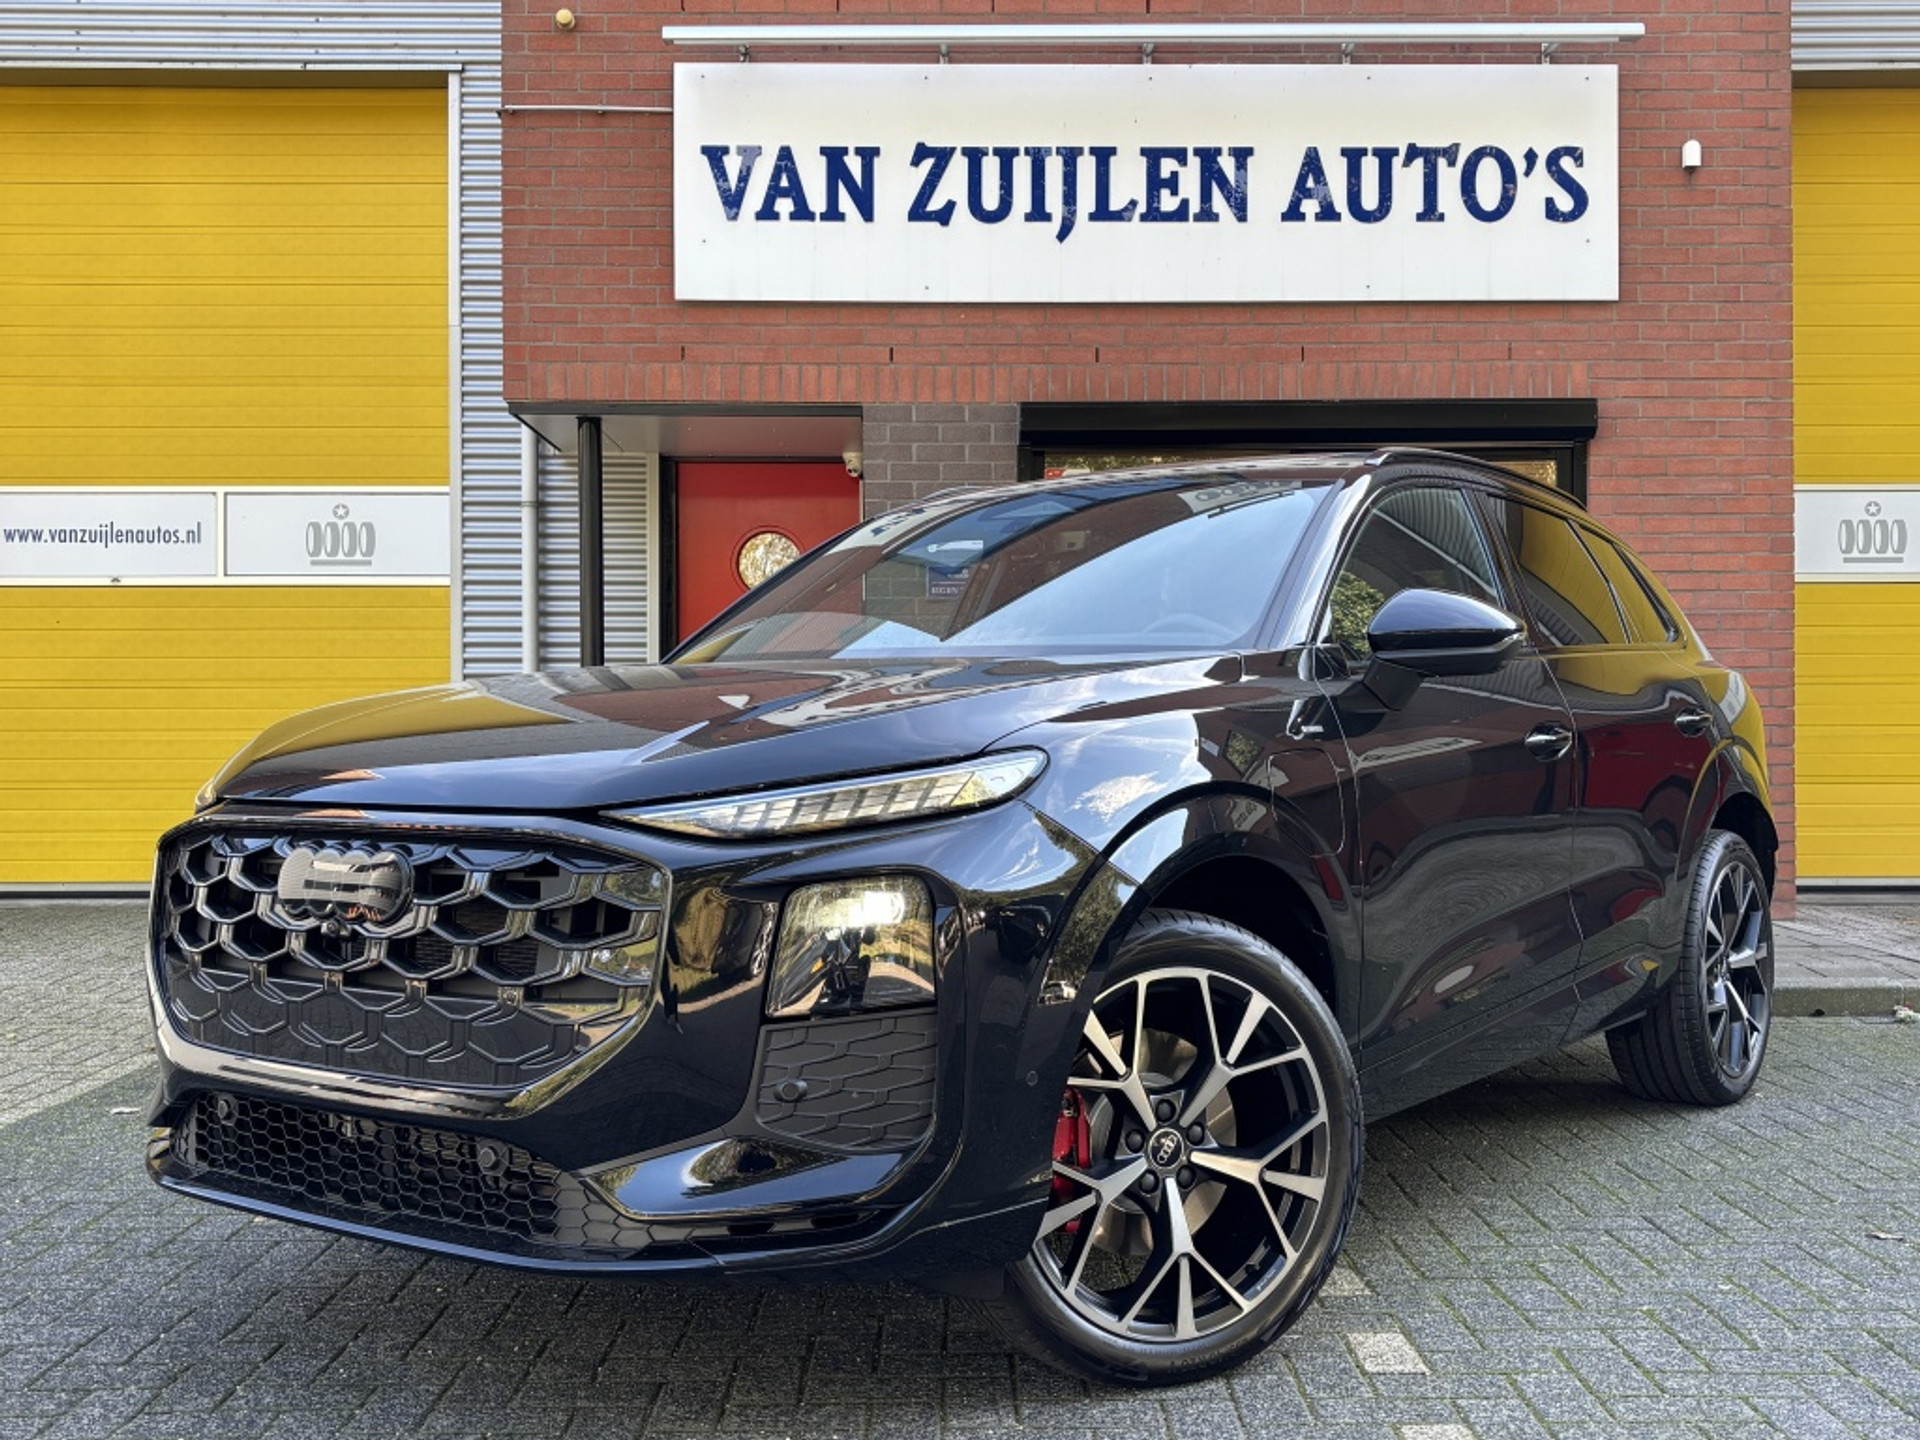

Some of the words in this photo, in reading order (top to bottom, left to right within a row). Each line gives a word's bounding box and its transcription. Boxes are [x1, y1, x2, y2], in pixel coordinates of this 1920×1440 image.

[700, 145, 880, 223] VAN
[907, 142, 1254, 243] ZUIJLEN
[1280, 143, 1591, 224] AUTO'S
[3, 521, 202, 548] www.vanzuijlenautos.nl
